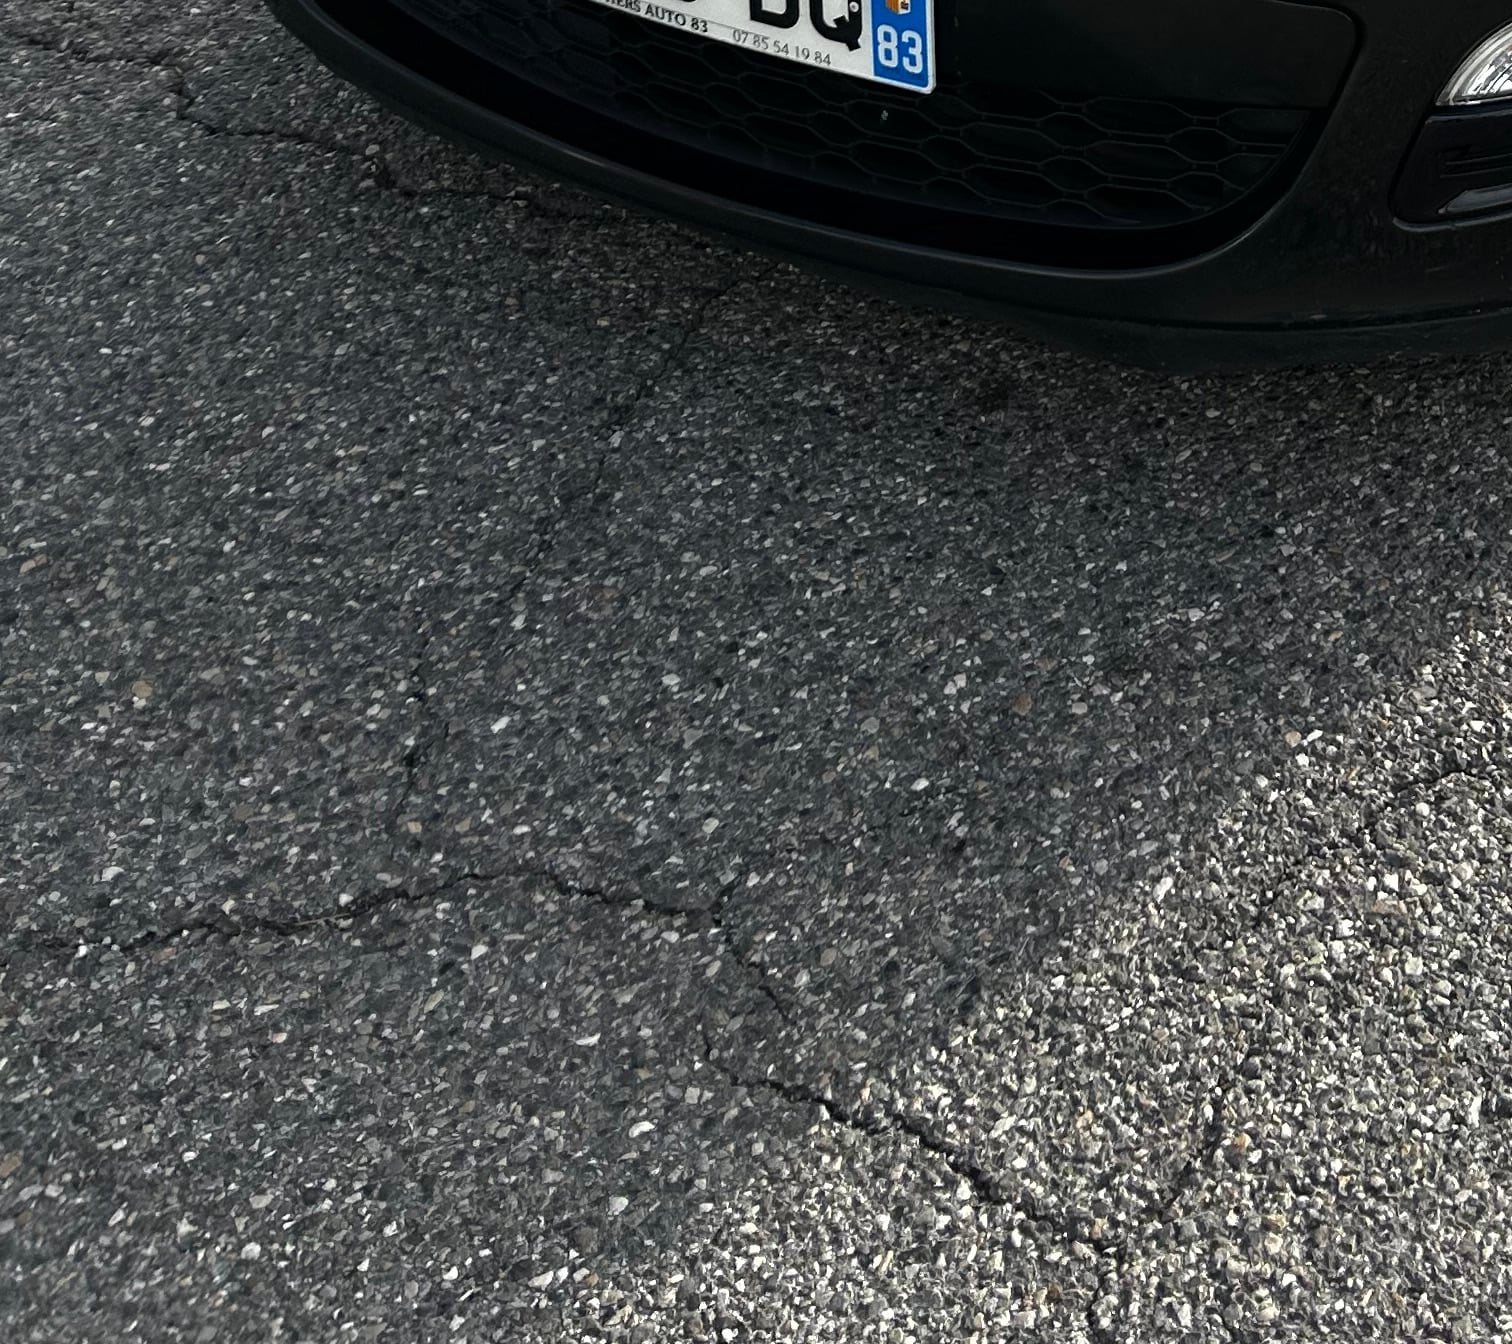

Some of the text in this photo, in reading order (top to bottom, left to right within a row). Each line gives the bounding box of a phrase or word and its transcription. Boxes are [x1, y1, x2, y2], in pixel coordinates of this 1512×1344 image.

[644, 3, 686, 26] AUTO
[691, 17, 708, 32] 83
[733, 29, 831, 65] 07 85 54 19 84
[877, 24, 923, 74] 83
